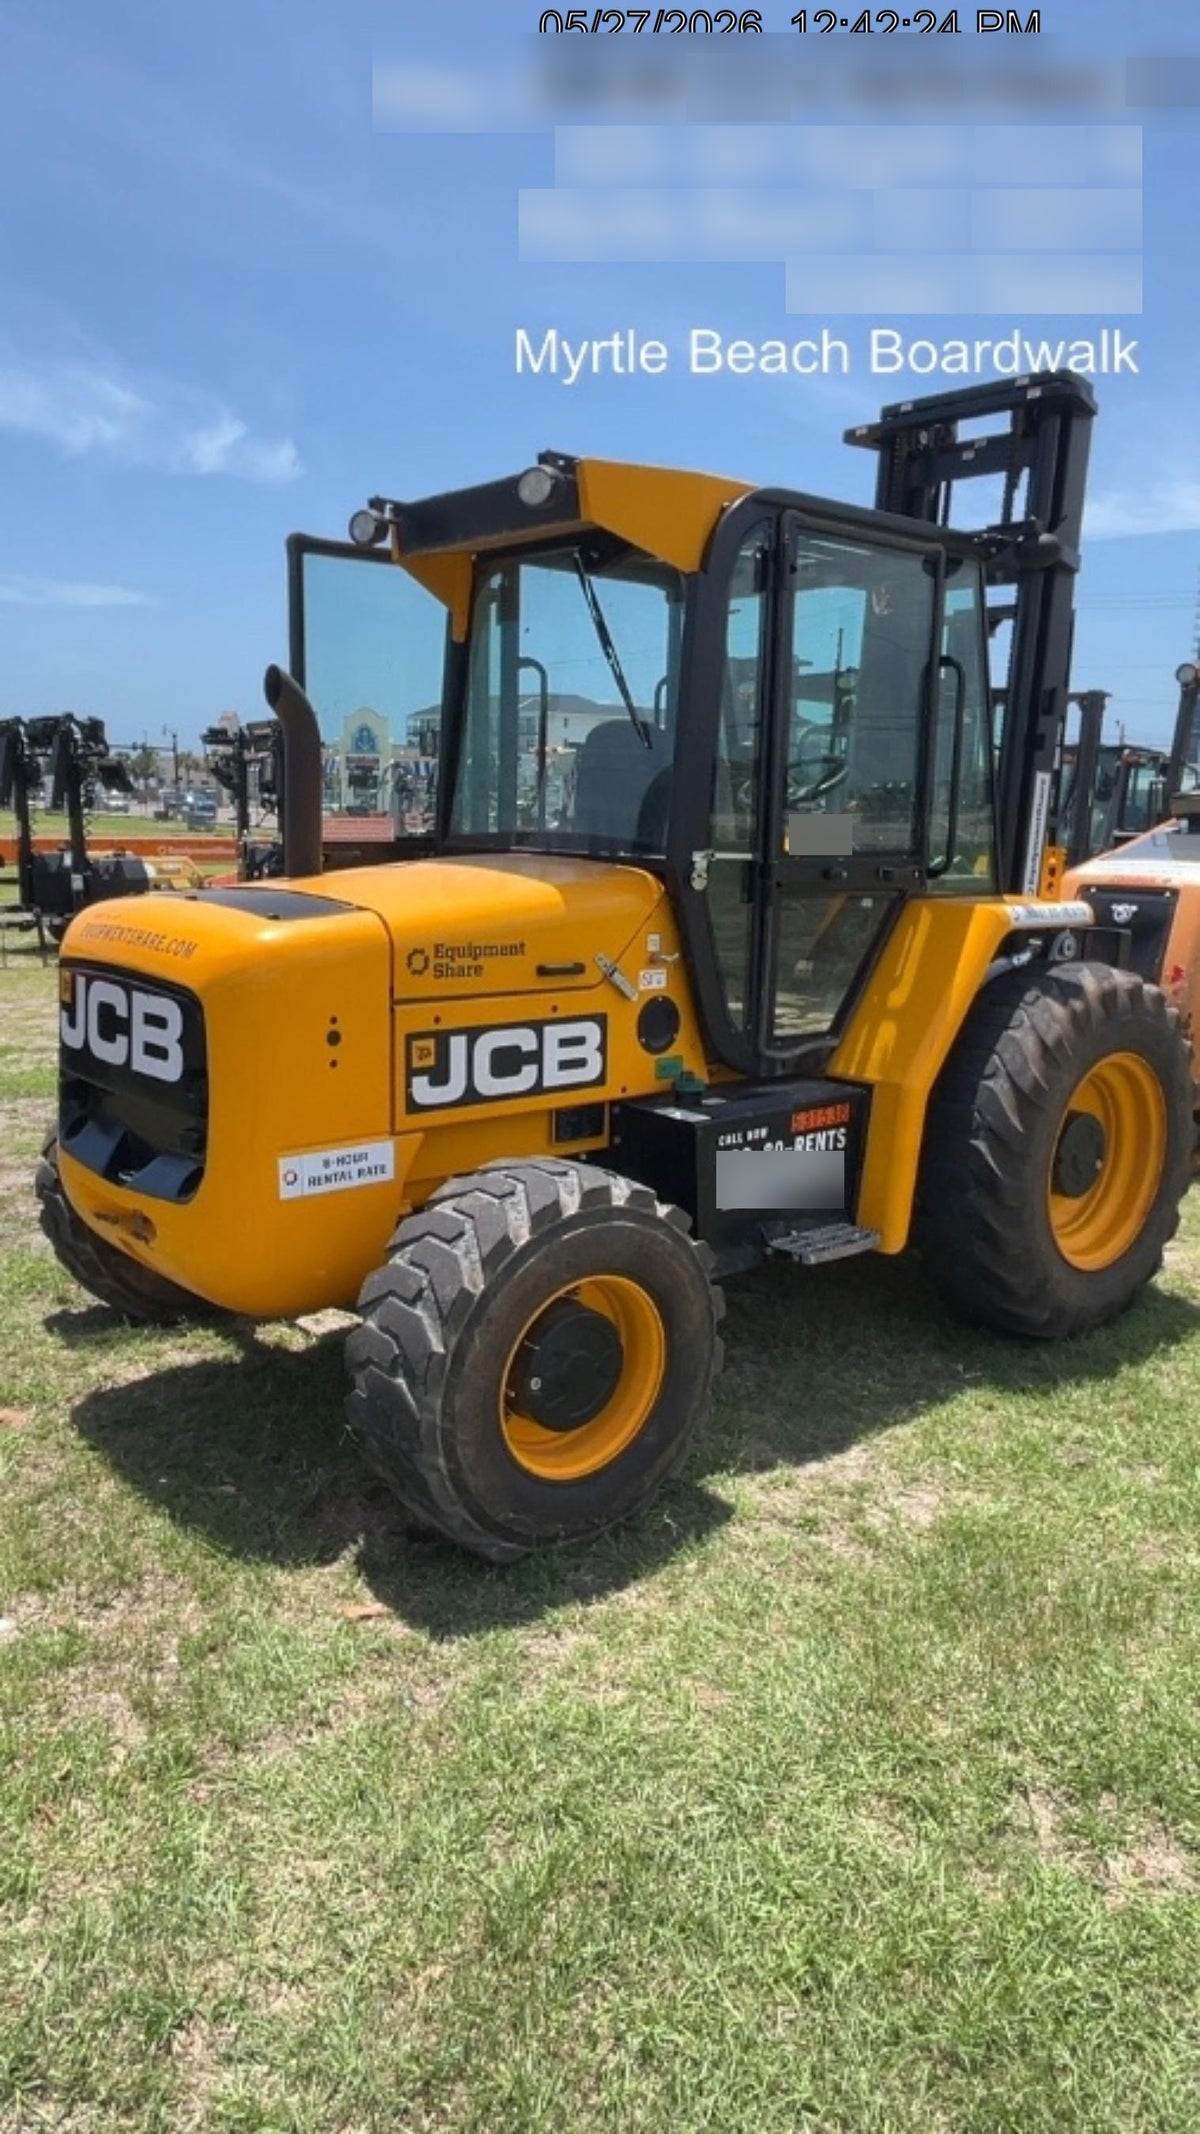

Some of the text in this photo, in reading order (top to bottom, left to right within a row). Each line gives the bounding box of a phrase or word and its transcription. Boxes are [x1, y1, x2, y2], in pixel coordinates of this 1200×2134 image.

[433, 941, 526, 962] Equipment
[433, 963, 484, 979] Share
[61, 973, 184, 1082] JCB
[411, 1021, 603, 1106] JCB
[308, 1164, 387, 1187] RENTAL RATE
